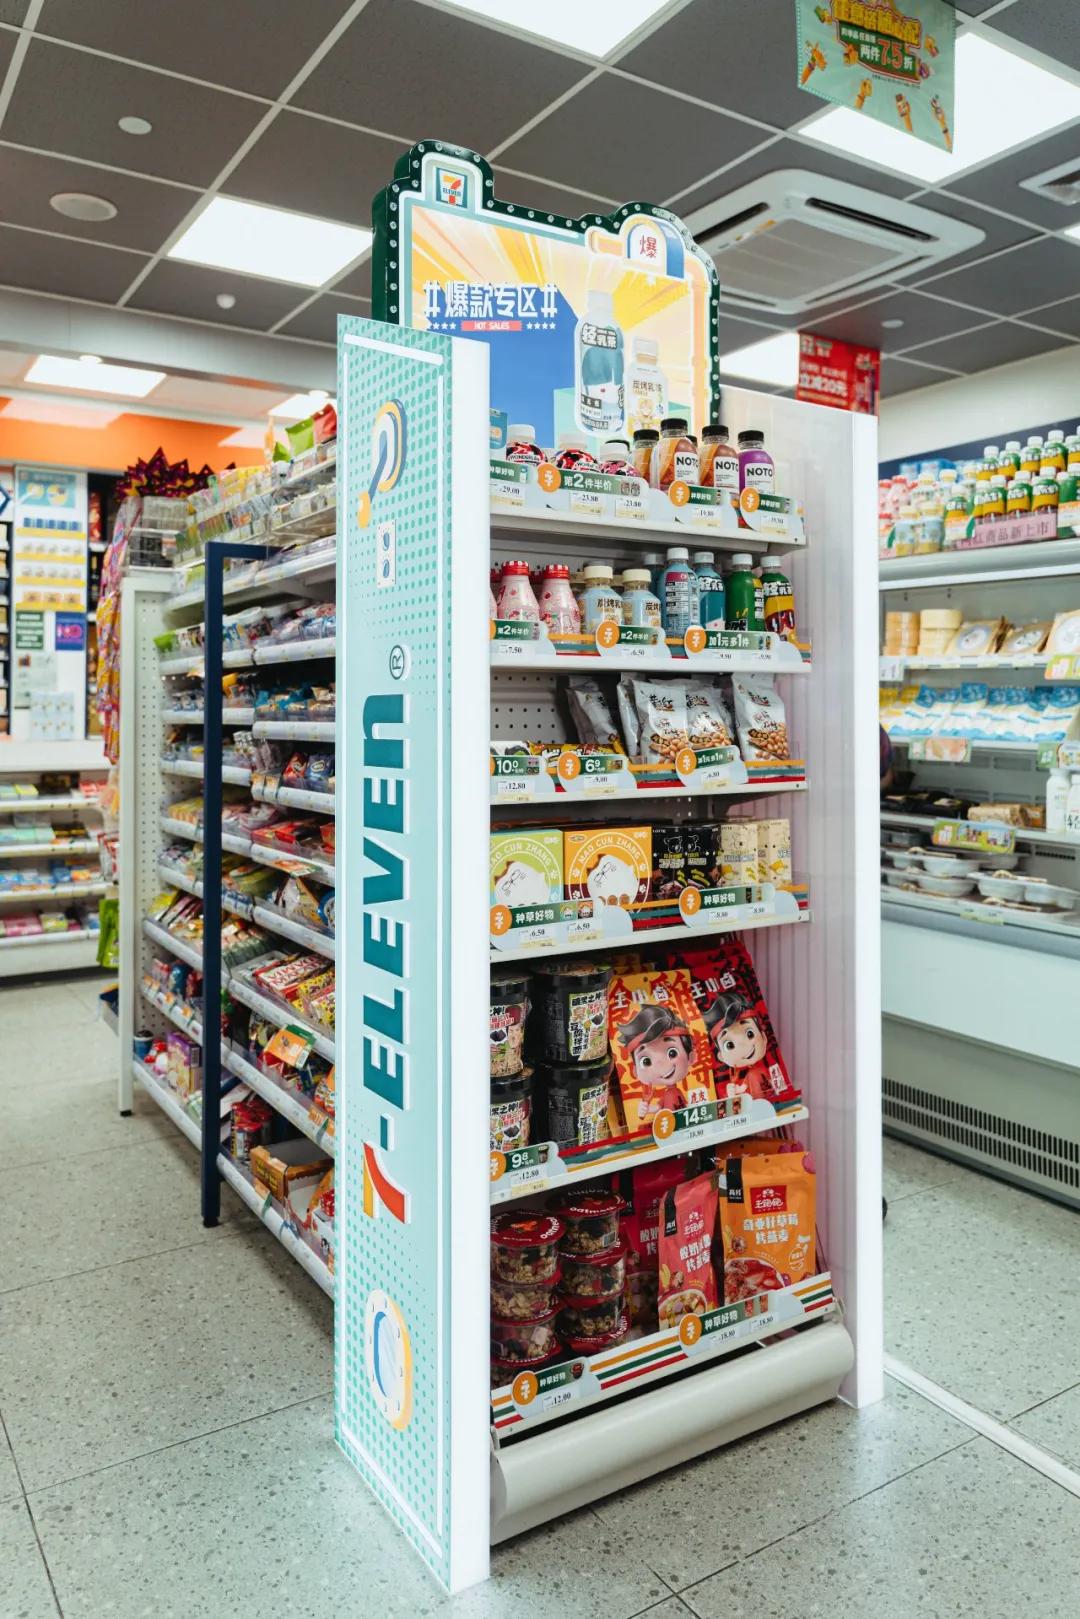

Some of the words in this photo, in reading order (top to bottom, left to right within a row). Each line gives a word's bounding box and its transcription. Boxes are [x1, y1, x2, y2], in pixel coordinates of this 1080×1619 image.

[474, 321, 487, 330] HOT
[489, 321, 510, 330] SALES
[563, 473, 613, 492] 第2件半价
[497, 624, 530, 636] 第2件半价
[503, 842, 522, 855] CUN
[525, 842, 552, 867] ZHANG
[578, 846, 594, 865] MAO
[595, 837, 614, 848] CUN
[616, 836, 642, 859] ZHANG
[703, 892, 736, 906] 种草好物
[515, 909, 555, 925] 种草好物
[691, 971, 737, 999] 王小卤
[612, 985, 669, 1010] 王小卤
[755, 1229, 789, 1245] 烤燕麦
[704, 1310, 738, 1331] 种草好物
[539, 1373, 566, 1387] 种草好物
